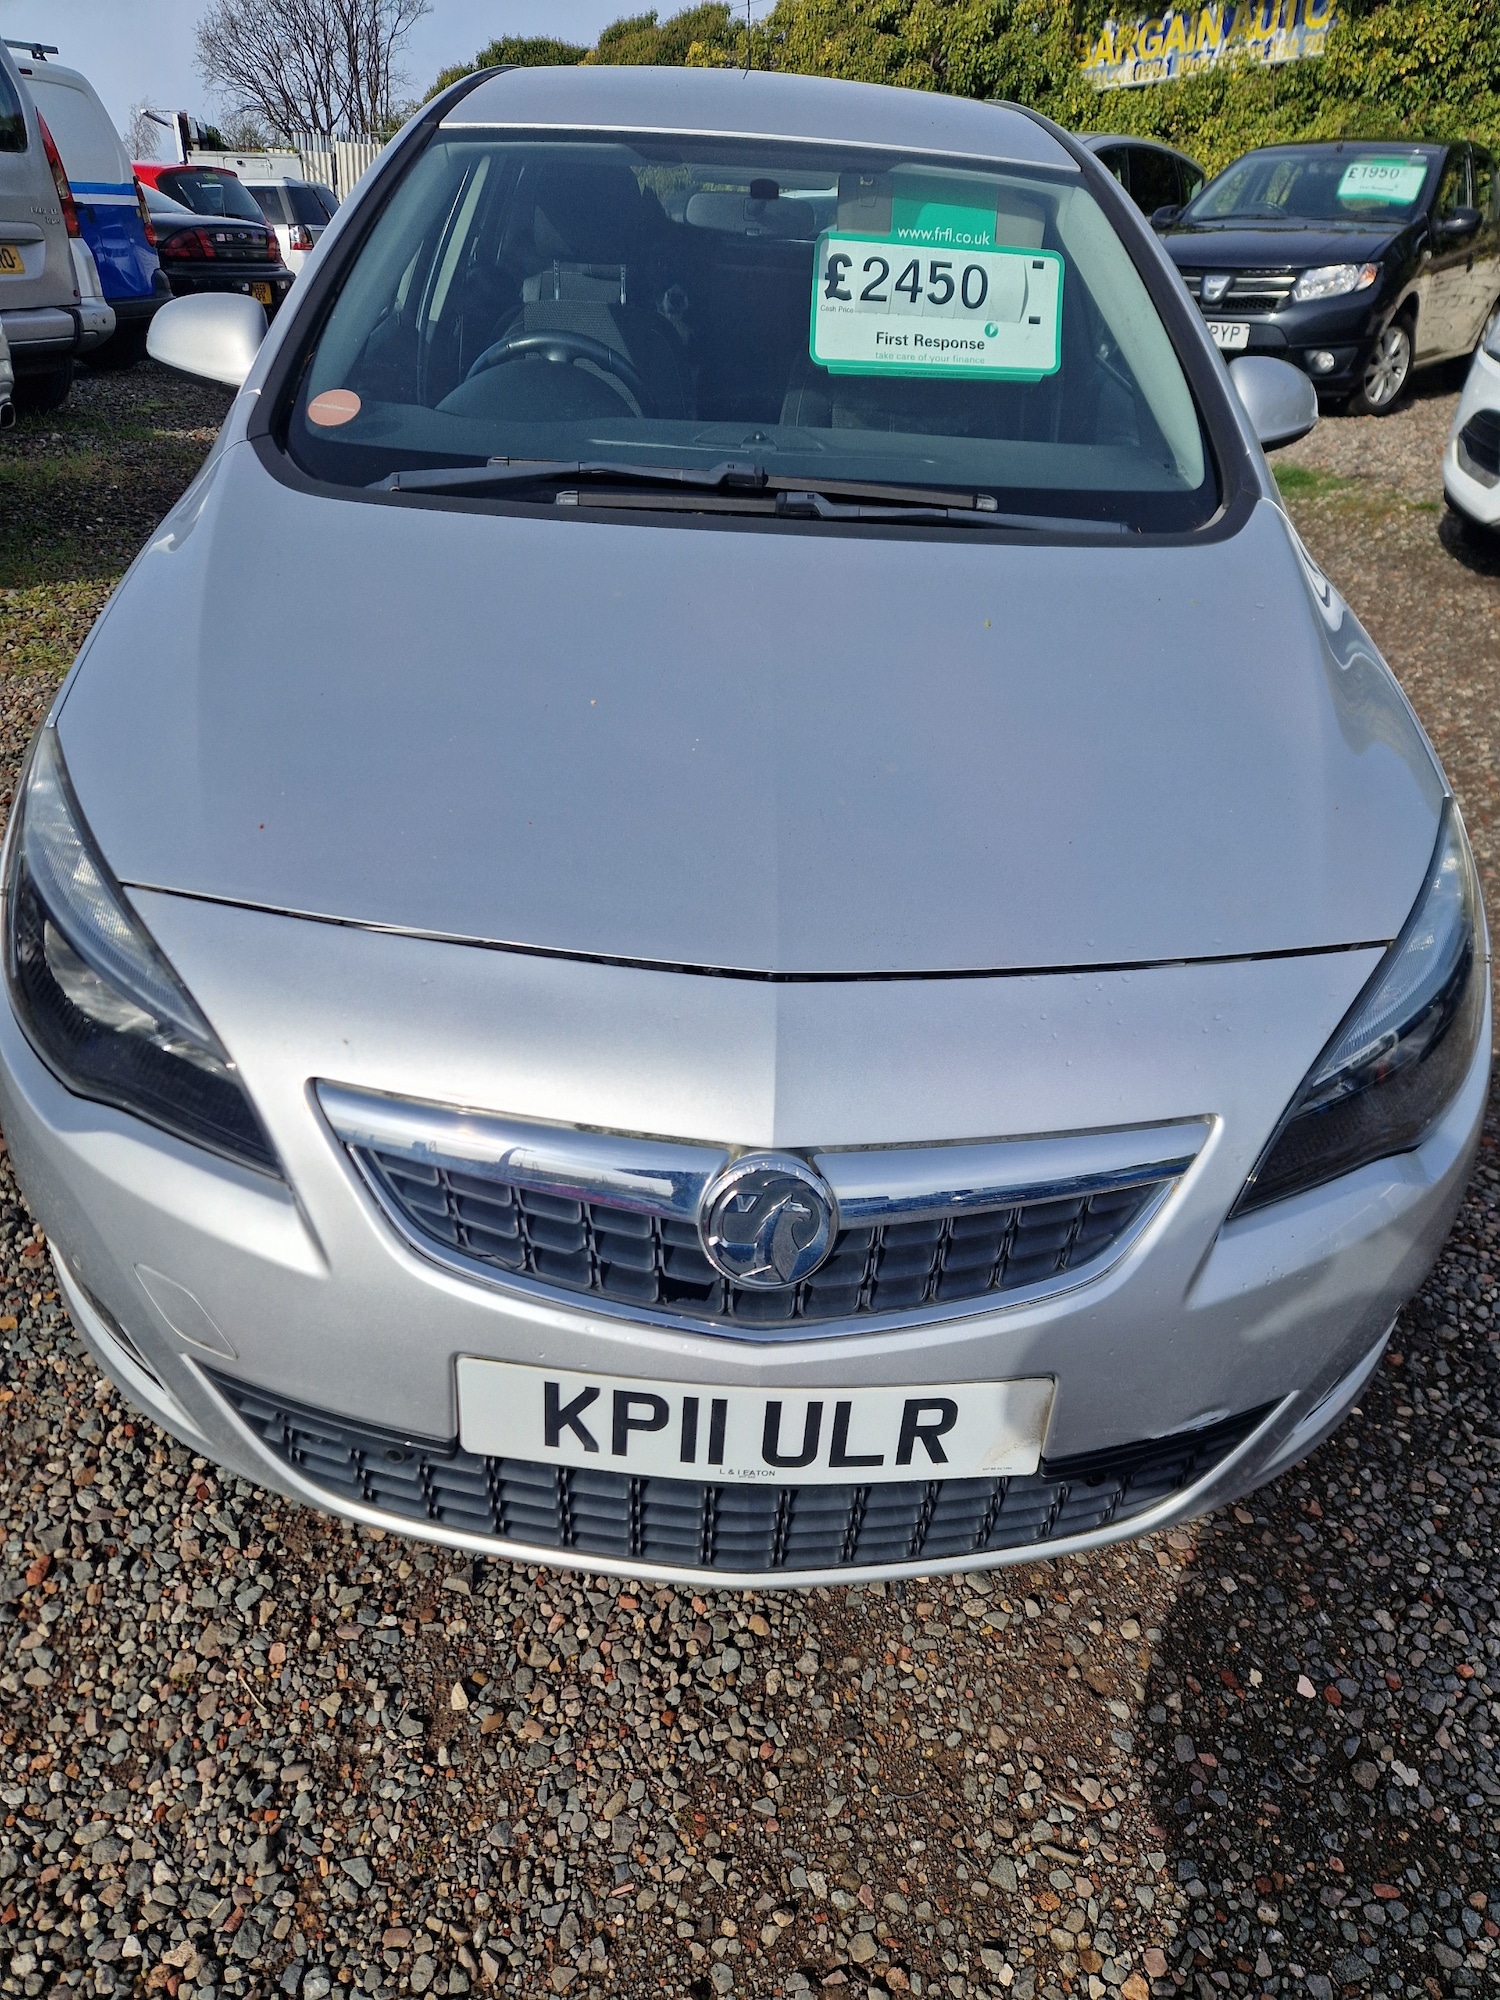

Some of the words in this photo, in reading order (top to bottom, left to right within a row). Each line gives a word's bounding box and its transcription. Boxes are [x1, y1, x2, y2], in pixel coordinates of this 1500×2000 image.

[1076, 3, 1224, 70] BARGAIN
[897, 226, 990, 246] www.frfl.co.uk
[824, 253, 989, 310] £2450
[820, 304, 837, 313] Cash
[838, 305, 854, 314] Price
[876, 331, 909, 346] First
[914, 334, 986, 351] Response
[875, 352, 894, 360] take
[917, 352, 928, 362] of
[929, 355, 950, 364] your
[952, 354, 986, 365] finance
[542, 1380, 729, 1467] KP11
[761, 1397, 959, 1469] ULR
[743, 1469, 776, 1477] EATON
